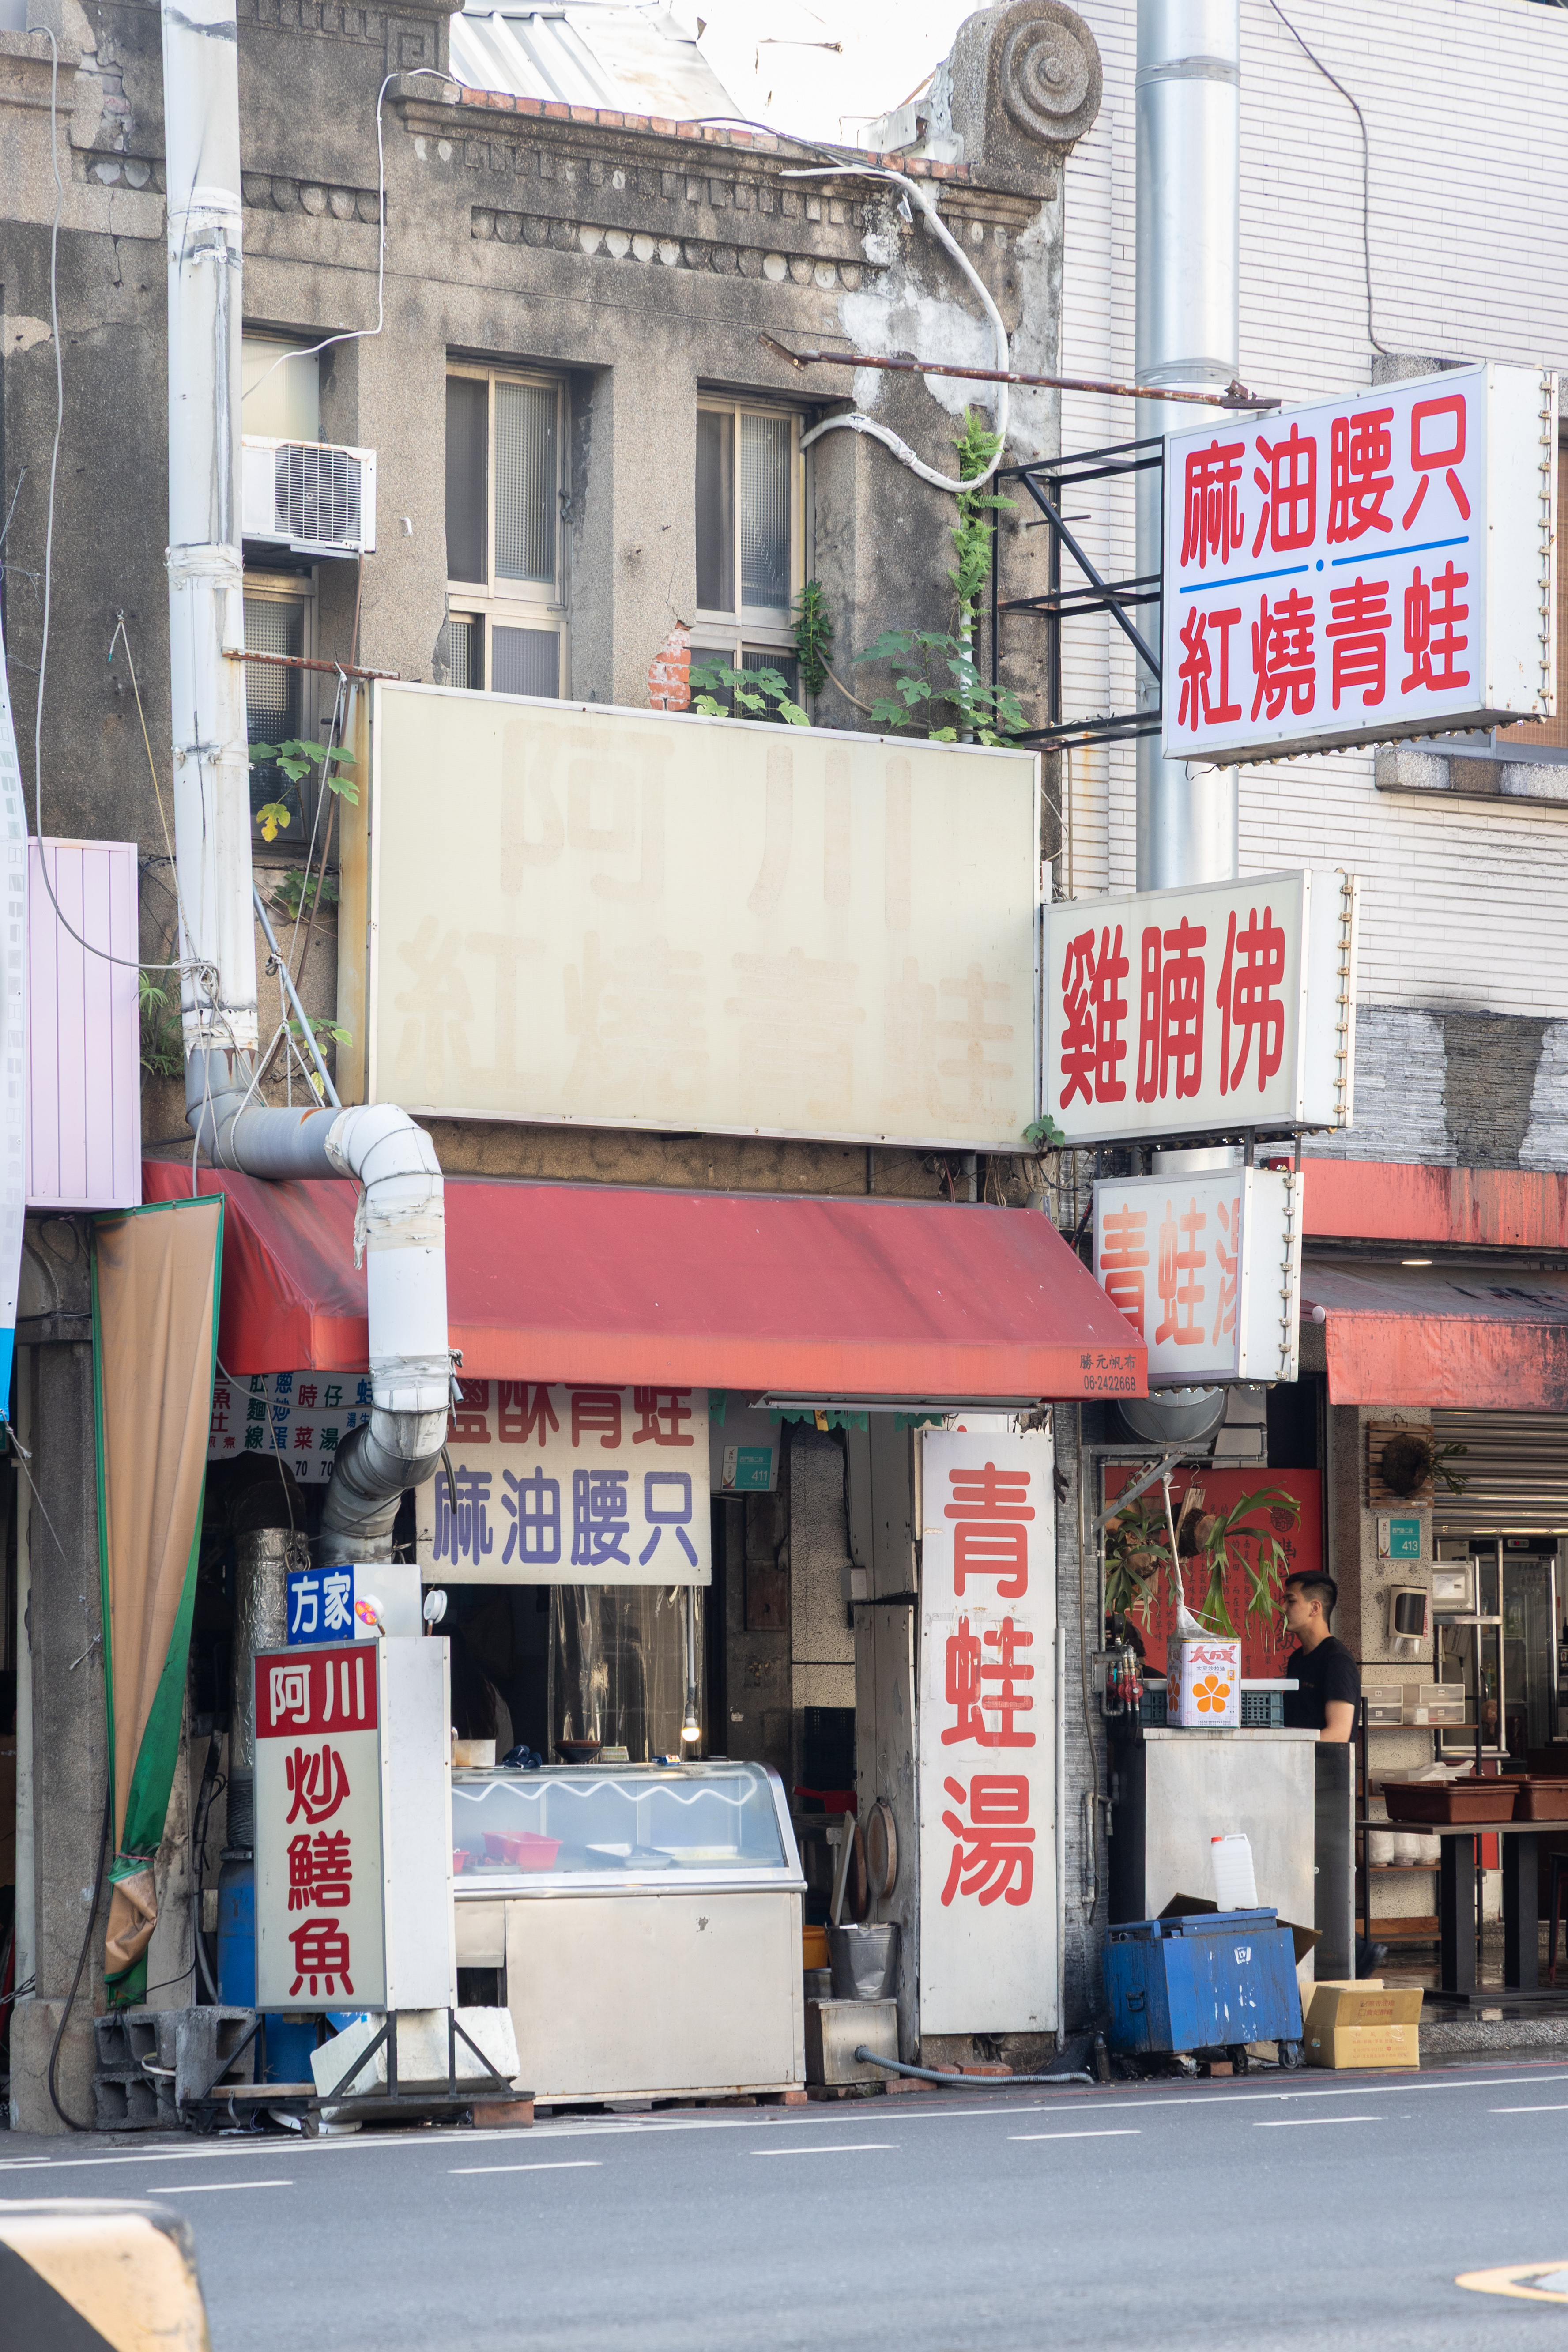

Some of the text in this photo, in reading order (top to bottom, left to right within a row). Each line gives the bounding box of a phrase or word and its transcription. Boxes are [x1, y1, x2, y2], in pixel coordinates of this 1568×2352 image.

[1180, 394, 1471, 569] 麻油腰只
[1178, 561, 1470, 732] 紅燒青蛙
[1060, 906, 1285, 1110] 雞腩佛
[1080, 1353, 1136, 1372] 勝元帆布
[295, 1460, 308, 1476] 70
[751, 1470, 768, 1481] 411
[432, 1464, 699, 1567] 麻油腰只
[1402, 1540, 1418, 1551] 413
[291, 1570, 352, 1634] 方家
[270, 1657, 365, 1726] 阿川
[940, 1462, 1036, 1907] 青蛙湯
[286, 1745, 354, 1996] 炒鱔魚
